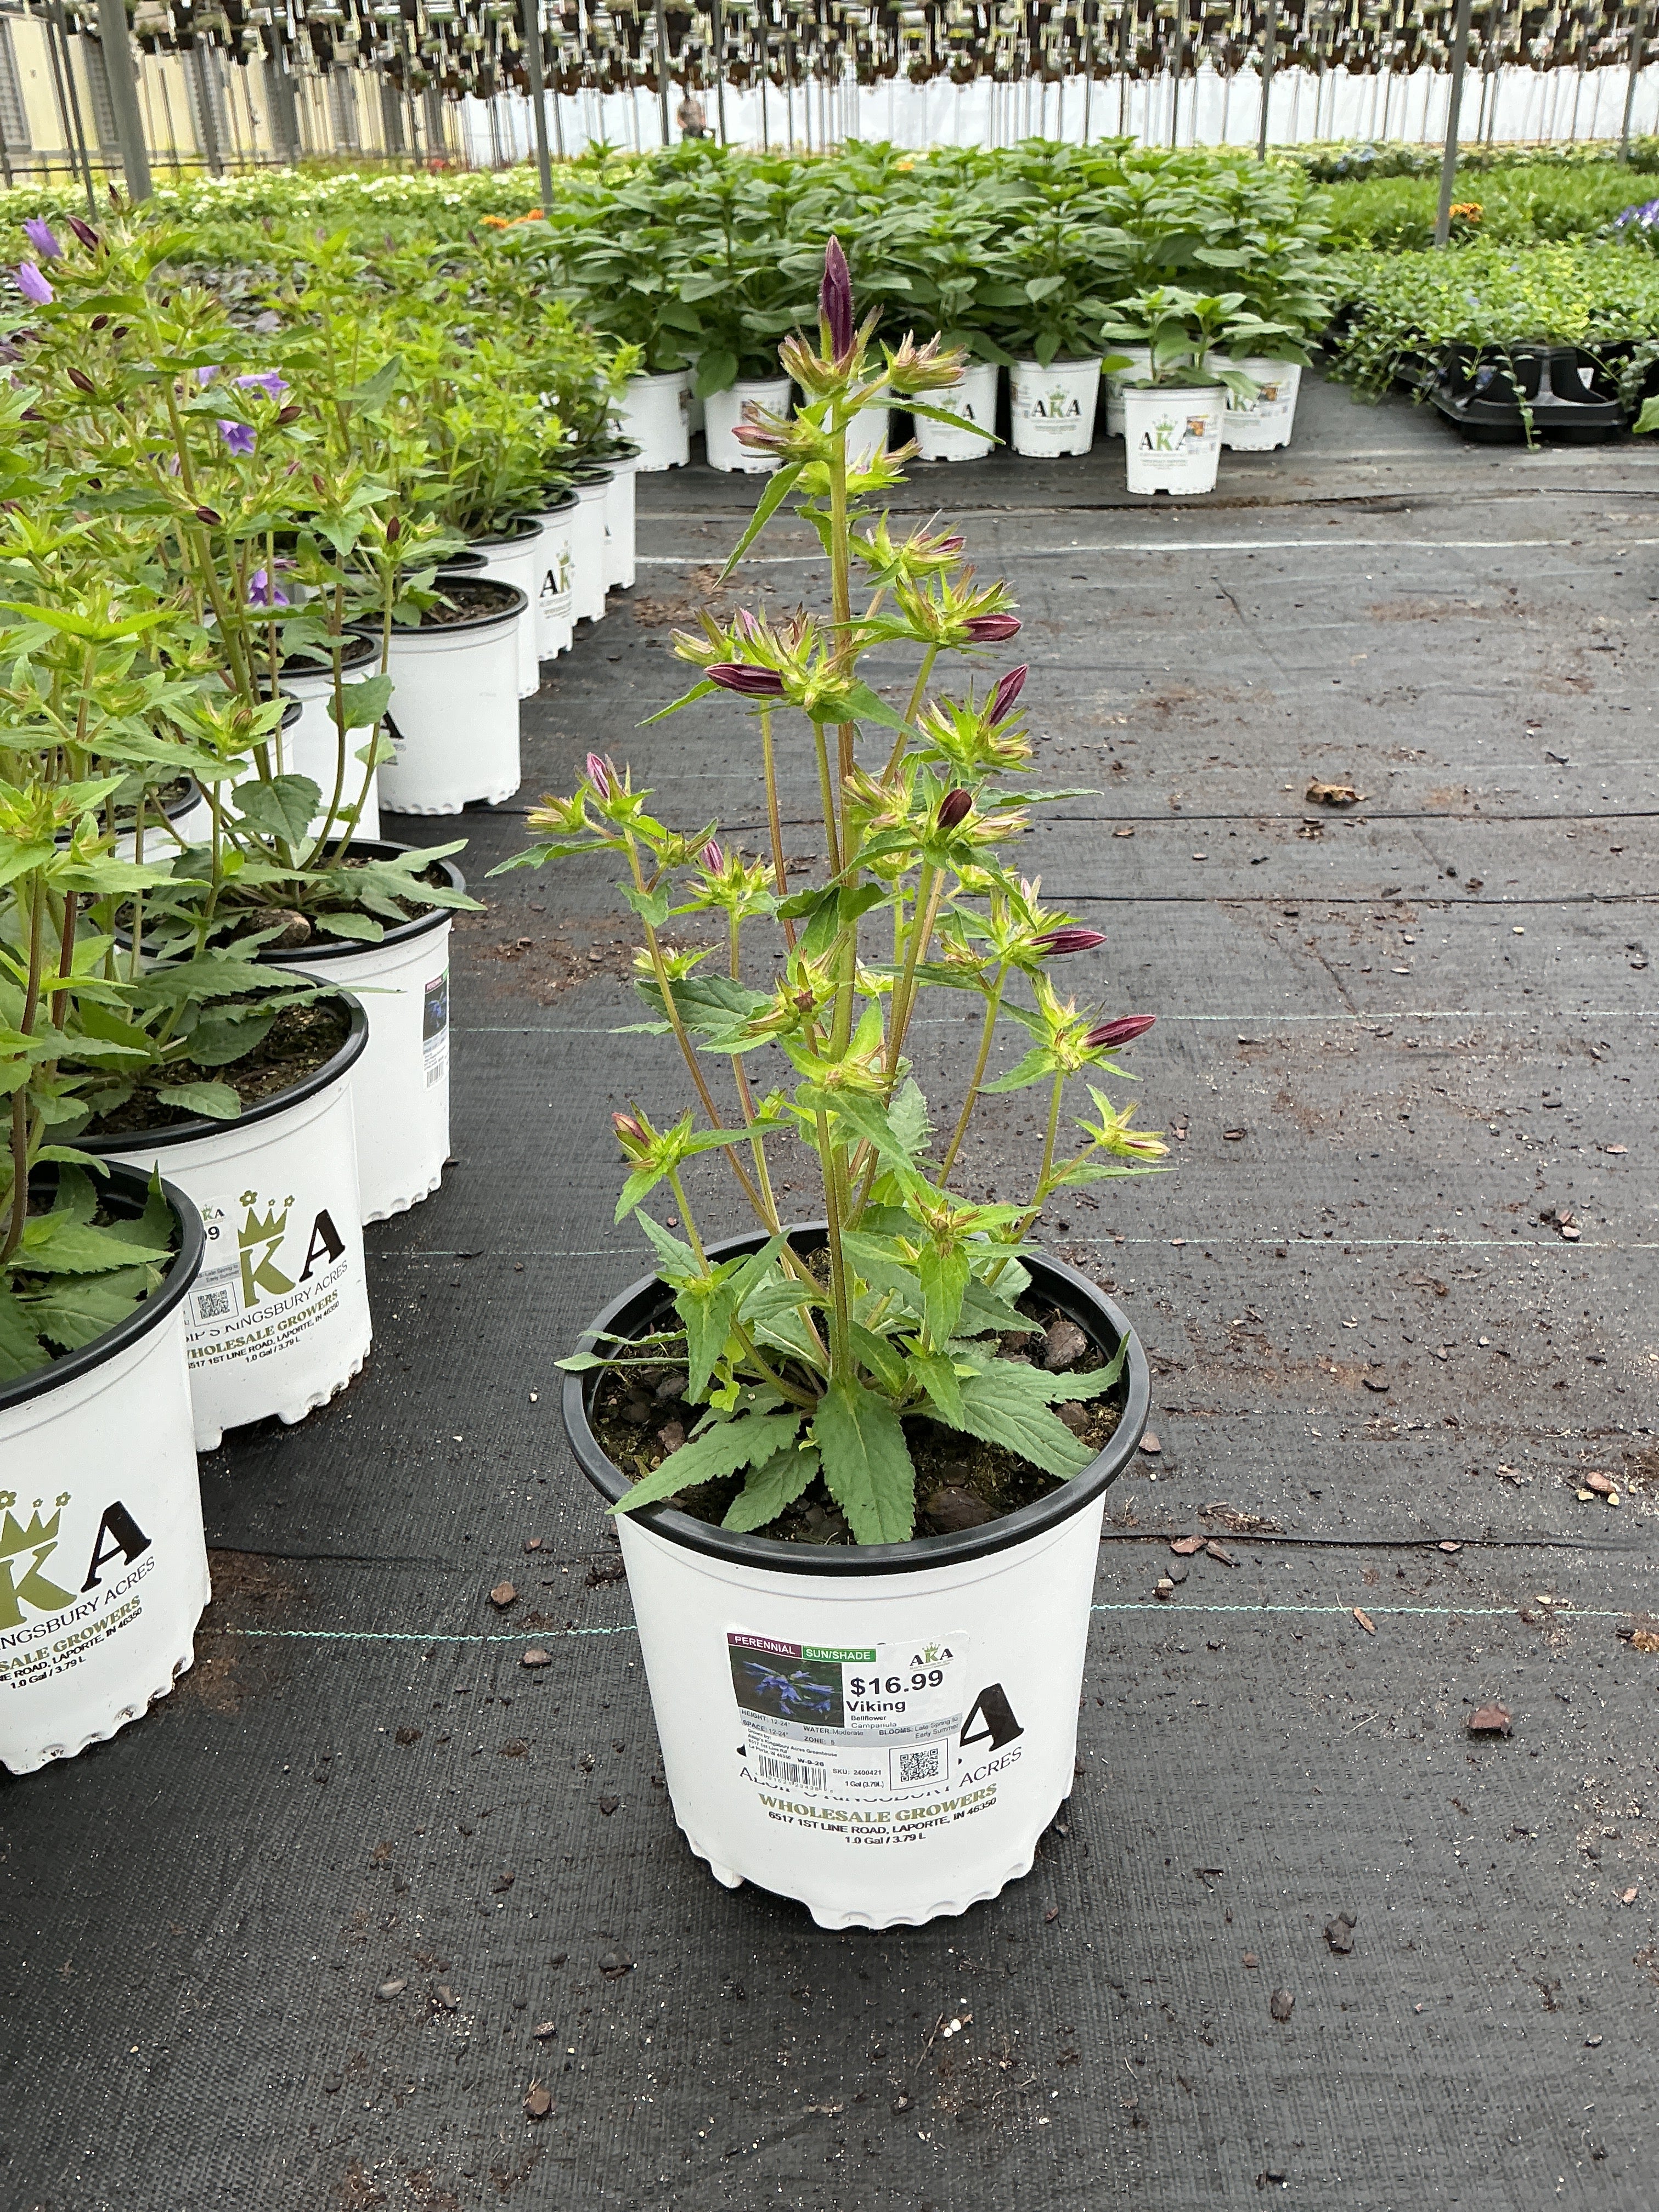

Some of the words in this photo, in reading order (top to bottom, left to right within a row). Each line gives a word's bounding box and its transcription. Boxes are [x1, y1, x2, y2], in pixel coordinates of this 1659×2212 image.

[1032, 399, 1081, 418] AKA
[314, 1260, 347, 1295] ACRES
[277, 1289, 338, 1331] GROWERS
[209, 1355, 224, 1364] 1ST
[227, 1349, 247, 1360] LINE
[315, 1313, 323, 1322] IN
[245, 1355, 257, 1364] 1.0
[259, 1348, 273, 1359] Gal
[278, 1339, 294, 1351] 3.79
[104, 1556, 155, 1605] ACRES
[53, 1595, 141, 1655] GROWERS
[106, 1626, 116, 1638] IN
[117, 1606, 143, 1629] 46350
[735, 1635, 795, 1655] PERENNIAL
[806, 1649, 871, 1660] SUN/SHADE
[910, 1648, 954, 1666] AKA
[10, 1679, 27, 1689] 1.0
[29, 1672, 47, 1684] Gal
[55, 1658, 77, 1674] 3.79
[850, 1669, 943, 1697] $16.99
[846, 1700, 906, 1713] Viking
[915, 1731, 931, 1739] Early
[933, 1723, 959, 1735] Summer
[930, 1719, 951, 1729] Spring
[958, 1746, 1023, 1787] ACRES
[758, 1792, 890, 1822] WHOLESALE
[895, 1783, 997, 1821] GROWERS
[769, 1812, 794, 1824] 6517
[797, 1819, 819, 1829] 1ST
[821, 1823, 849, 1833] LINE
[893, 1816, 950, 1832] LAPORTE,
[953, 1810, 964, 1820] IN
[967, 1797, 997, 1815] 46350
[864, 1836, 883, 1844] Gal
[893, 1835, 916, 1843] 3.79
